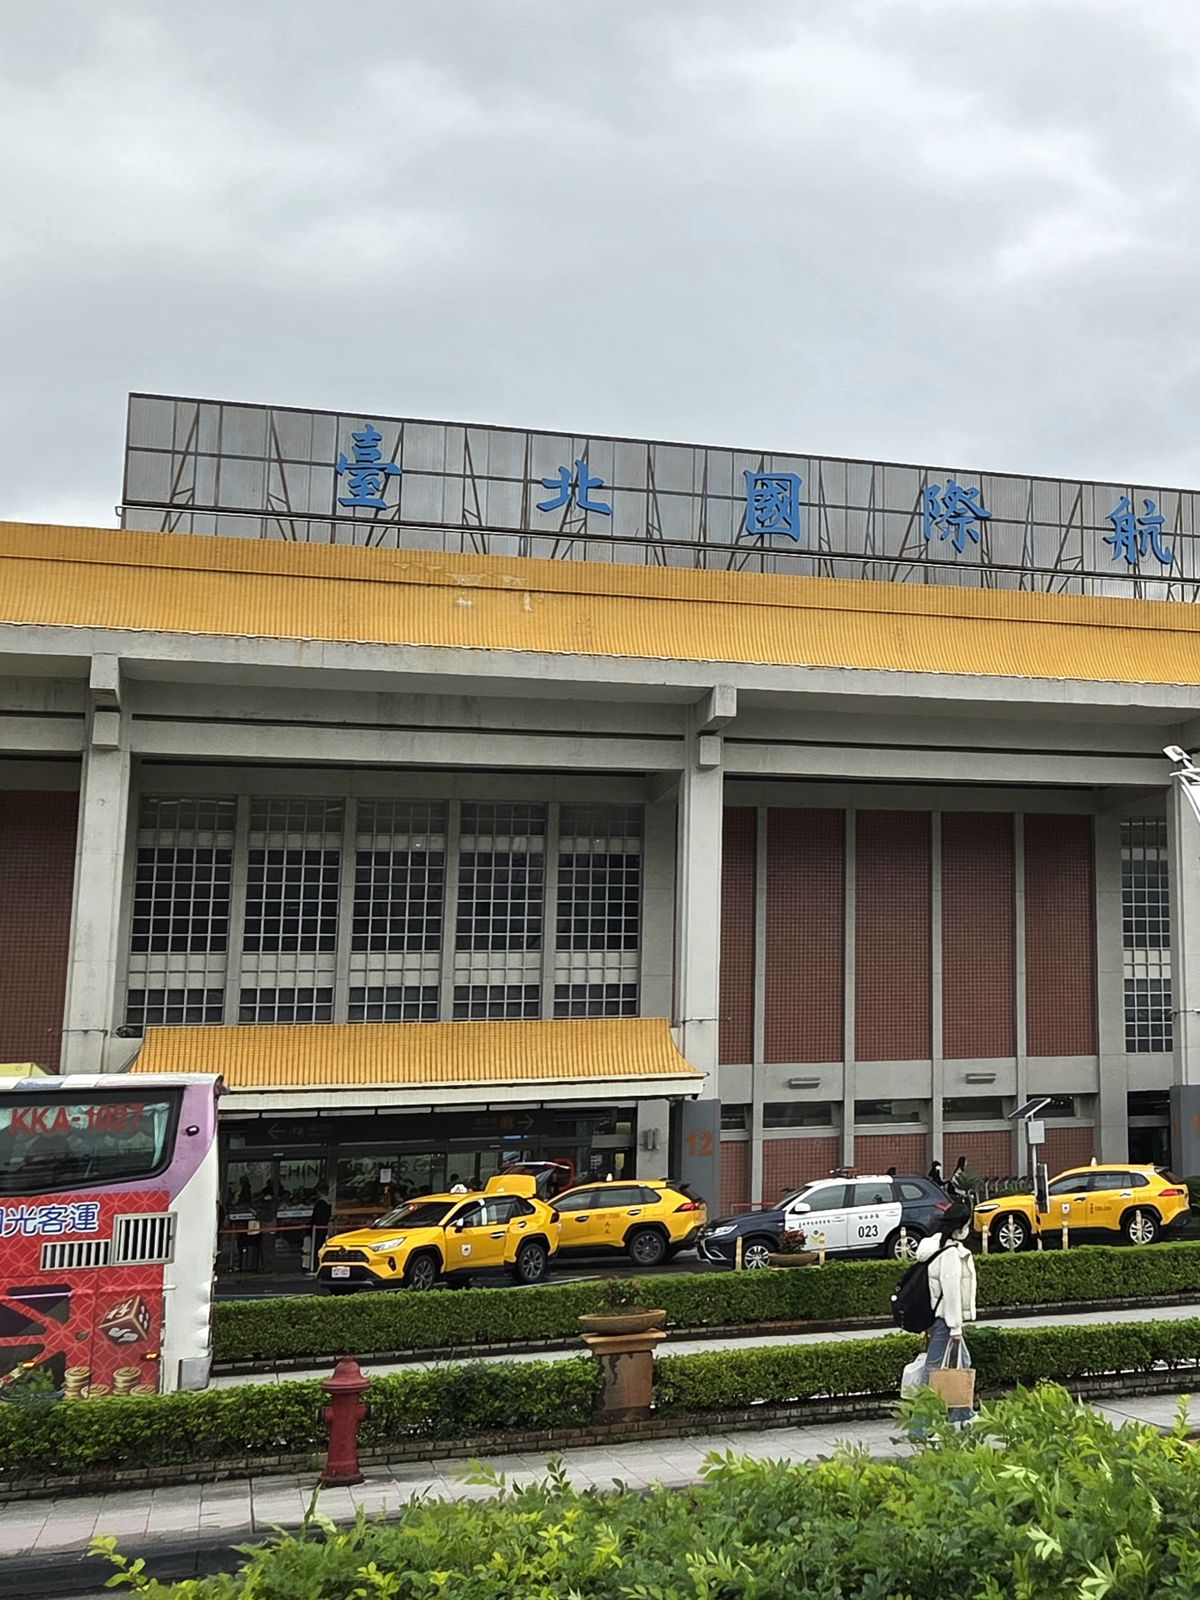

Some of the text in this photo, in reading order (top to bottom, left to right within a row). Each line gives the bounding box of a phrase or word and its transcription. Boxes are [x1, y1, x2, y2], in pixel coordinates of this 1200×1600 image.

[687, 1131, 713, 1158] 12
[0, 1202, 100, 1237] 光客運
[858, 1225, 879, 1238] 023
